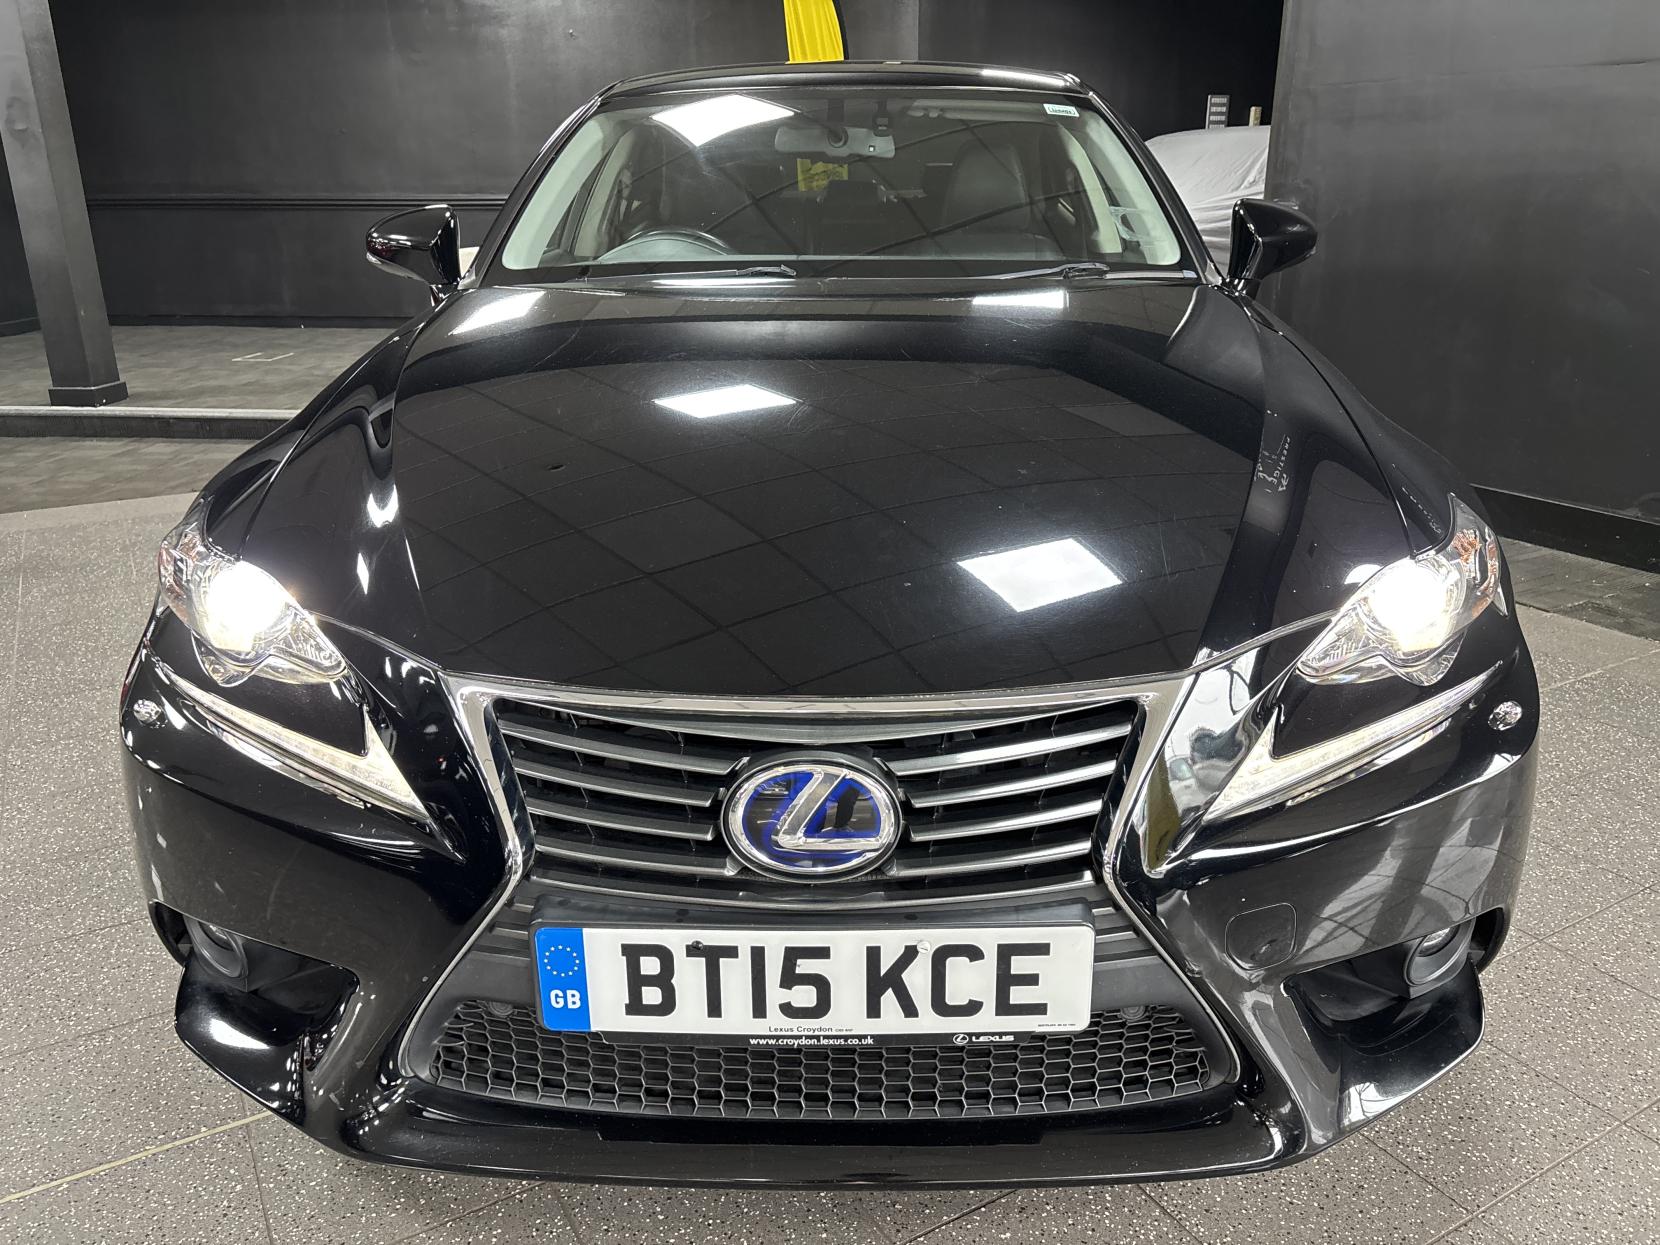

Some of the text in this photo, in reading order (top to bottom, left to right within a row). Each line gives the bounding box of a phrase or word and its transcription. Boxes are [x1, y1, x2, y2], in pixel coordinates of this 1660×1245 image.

[620, 941, 1051, 1020] BT15 KCE
[549, 989, 582, 1009] GB
[768, 1025, 795, 1033] Lexus
[796, 1025, 833, 1034] Croydon
[749, 1035, 874, 1048] www.croydon.lexus.co.uk
[971, 1034, 1015, 1042] LEXUS
